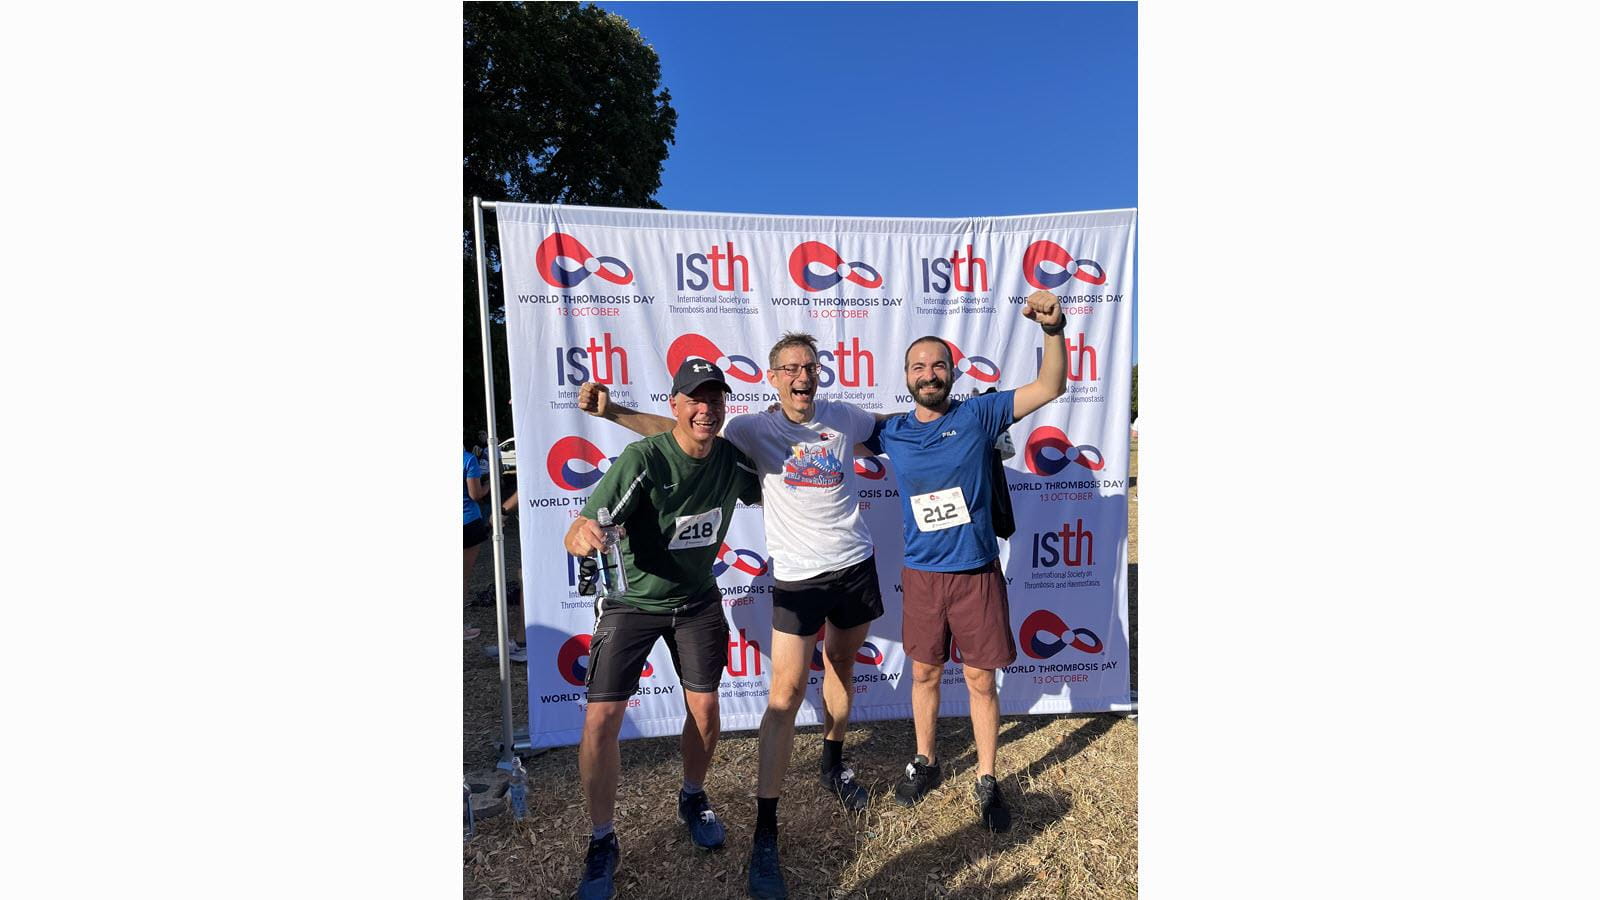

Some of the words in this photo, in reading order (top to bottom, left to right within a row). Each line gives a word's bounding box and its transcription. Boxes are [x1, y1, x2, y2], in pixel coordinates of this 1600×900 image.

[518, 295, 559, 304] WORLD
[562, 295, 630, 304] THROMBOSIS
[633, 296, 655, 305] DAY
[677, 295, 717, 304] International
[718, 295, 740, 305] Society
[771, 297, 810, 306] WORLD
[813, 297, 879, 306] THROMBOSIS
[882, 298, 903, 307] DAY
[923, 296, 958, 305] International
[960, 295, 980, 305] Society
[981, 296, 990, 304] on
[1106, 294, 1123, 303] DAY
[558, 307, 569, 316] 13
[572, 307, 620, 317] OCTOBER
[669, 305, 705, 314] Thrombosis
[706, 305, 718, 314] and
[719, 305, 759, 315] Haemostasis
[808, 309, 818, 318] 13
[821, 309, 869, 318] OCTOBER
[916, 306, 948, 315] Thrombosis
[949, 306, 960, 315] and
[961, 305, 997, 314] Haemostasis
[1063, 306, 1094, 315] TOBER
[817, 337, 875, 388] Sth
[1070, 386, 1089, 394] Society
[844, 391, 866, 400] Society
[942, 430, 957, 438] FILA
[1009, 482, 1042, 492] WORLD
[1045, 480, 1101, 490] THROMBOSIS
[1103, 480, 1124, 488] DAY
[1040, 493, 1049, 502] 13
[1051, 492, 1093, 501] OCTOBER
[529, 497, 570, 508] WORLD
[923, 503, 958, 523] 212
[679, 522, 713, 540] 218
[724, 597, 754, 607] TOBER
[1001, 665, 1036, 674] WORLD
[1039, 662, 1099, 673] THROMBOSIS
[1101, 661, 1117, 671] DAY
[880, 673, 900, 681] DAY
[1033, 675, 1043, 684] 13
[1045, 674, 1089, 684] OCTOBER
[732, 680, 753, 688] Society
[654, 685, 675, 694] DAY
[721, 690, 732, 698] and
[541, 693, 580, 704] WORLD
